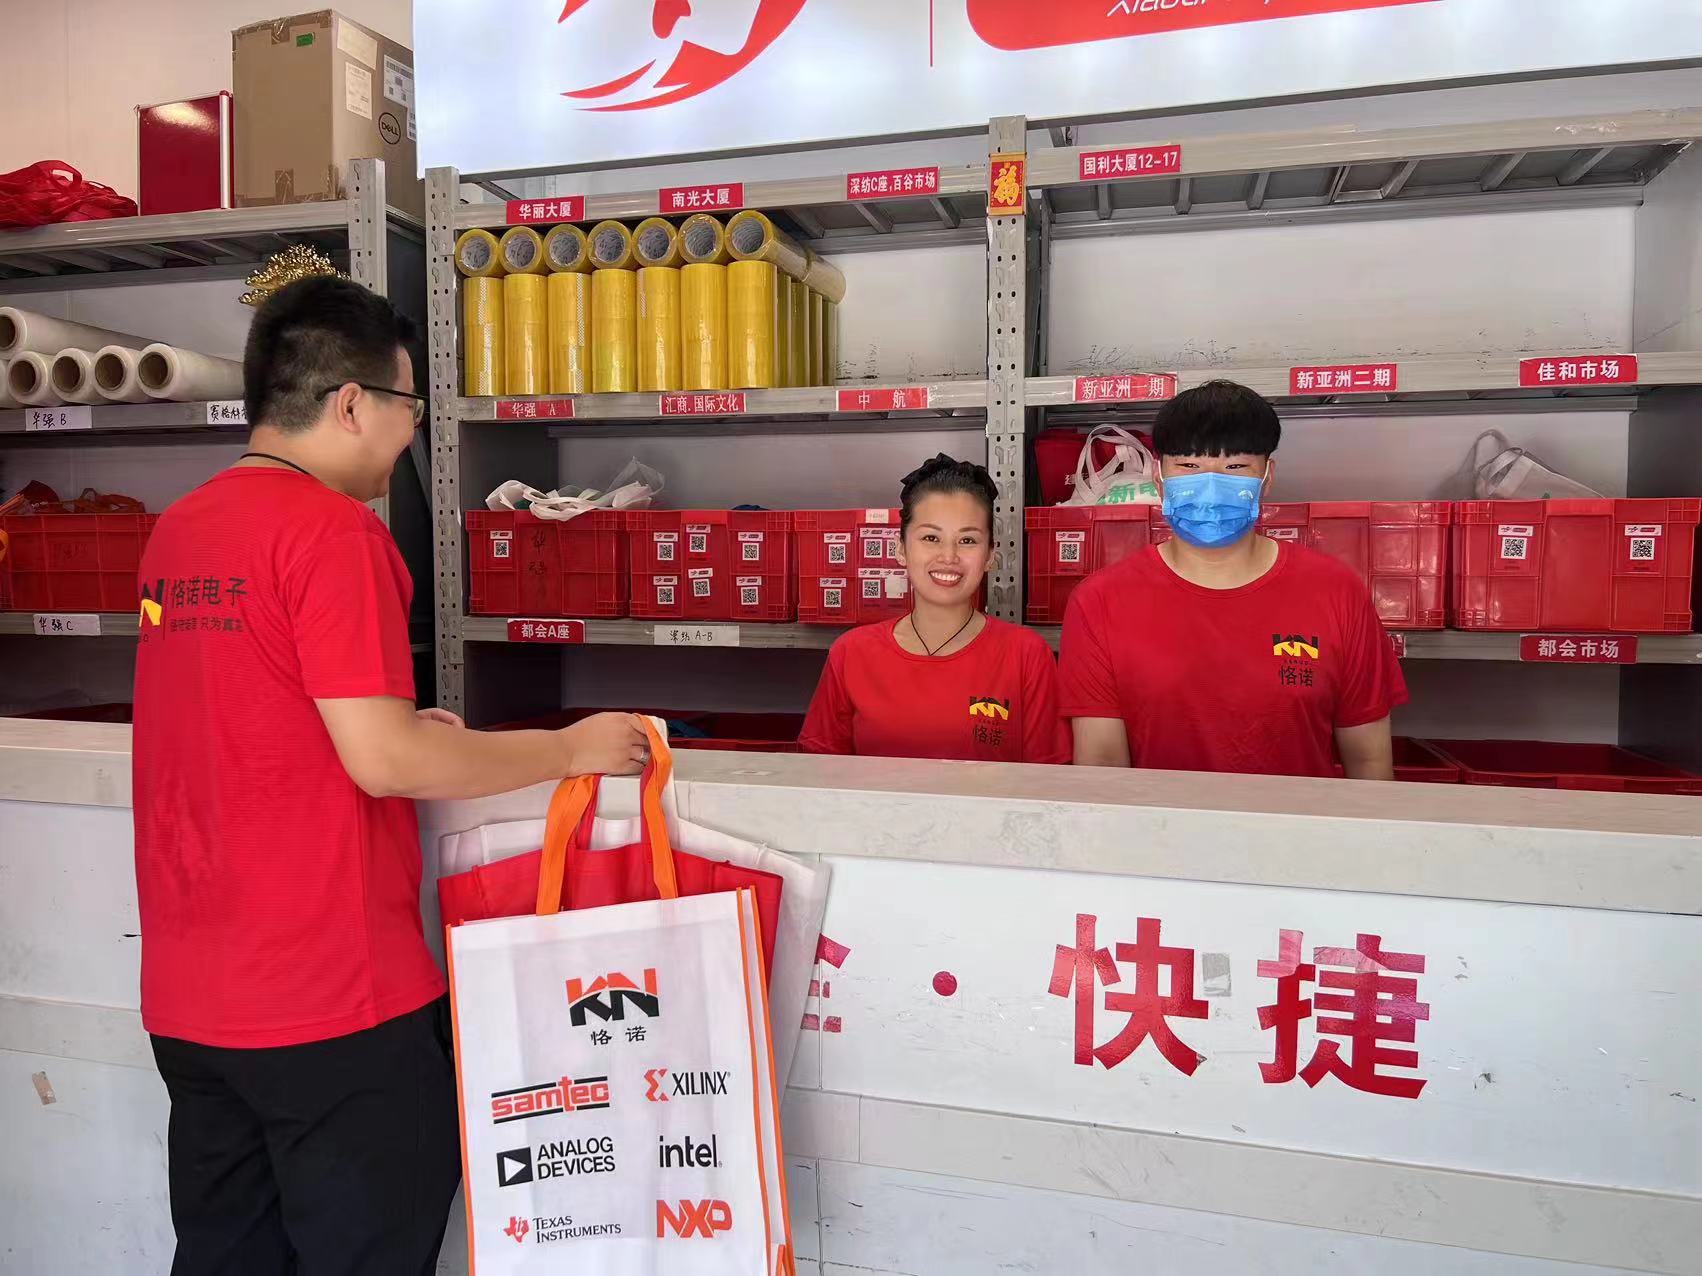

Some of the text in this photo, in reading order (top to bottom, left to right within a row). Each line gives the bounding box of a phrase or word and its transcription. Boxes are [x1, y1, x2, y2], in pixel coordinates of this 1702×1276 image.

[381, 121, 399, 136] DELL
[1083, 152, 1178, 175] 国利大厦12-17
[672, 188, 730, 208] 南光大厦
[519, 201, 572, 220] 华丽大厦
[1297, 369, 1390, 389] 新亚洲二期
[1537, 360, 1629, 381] 佳和市场
[1082, 377, 1164, 399] 新亚洲一期
[60, 413, 67, 426] B
[511, 402, 556, 418] 华强 A
[171, 575, 248, 609] 恪诺电子
[66, 620, 74, 631] C
[521, 623, 570, 639] 都会A座
[1537, 639, 1619, 658] 都会市场
[1280, 664, 1313, 687] 恪诺
[565, 968, 660, 1027] KN
[672, 1071, 728, 1096] XILINX
[491, 1076, 610, 1118] samtec
[537, 1136, 613, 1160] ANALOG
[659, 1134, 718, 1168] intel
[537, 1155, 616, 1180] DEVICES
[532, 1215, 573, 1231] TEXAS
[656, 1199, 733, 1238] NXP
[536, 1223, 622, 1243] INSTRUMENTS
